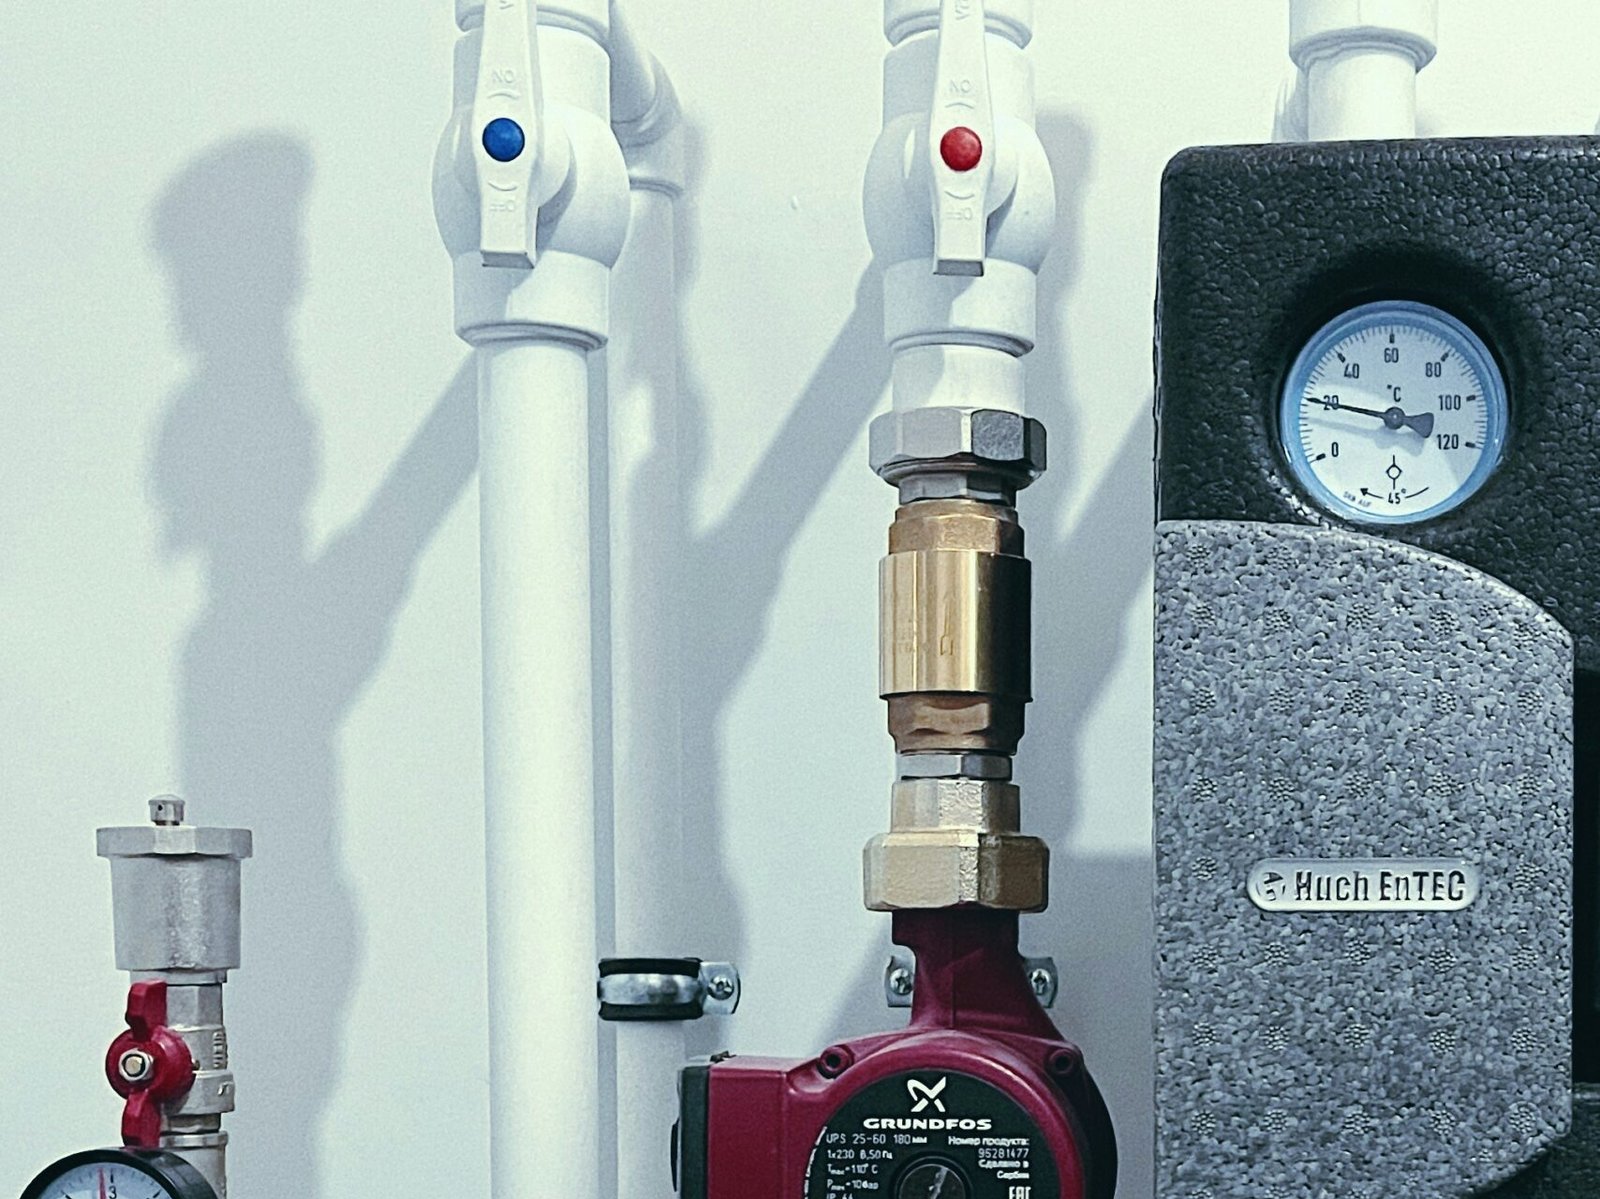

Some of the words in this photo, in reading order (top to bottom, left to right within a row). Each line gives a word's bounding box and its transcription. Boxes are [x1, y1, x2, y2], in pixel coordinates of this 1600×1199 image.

[1384, 347, 1399, 363] 60
[1344, 363, 1359, 379] 40
[1425, 362, 1442, 378] 80
[1323, 395, 1340, 410] 20
[1438, 395, 1461, 411] 100
[1331, 442, 1339, 457] 0
[1437, 434, 1459, 450] 120
[1295, 870, 1369, 901] Huch
[1379, 870, 1465, 901] EnTEC
[863, 1118, 992, 1130] GRUNDFOS
[826, 1133, 846, 1144] UPS
[852, 1133, 886, 1144] 25-60
[109, 1186, 117, 1199] 3
